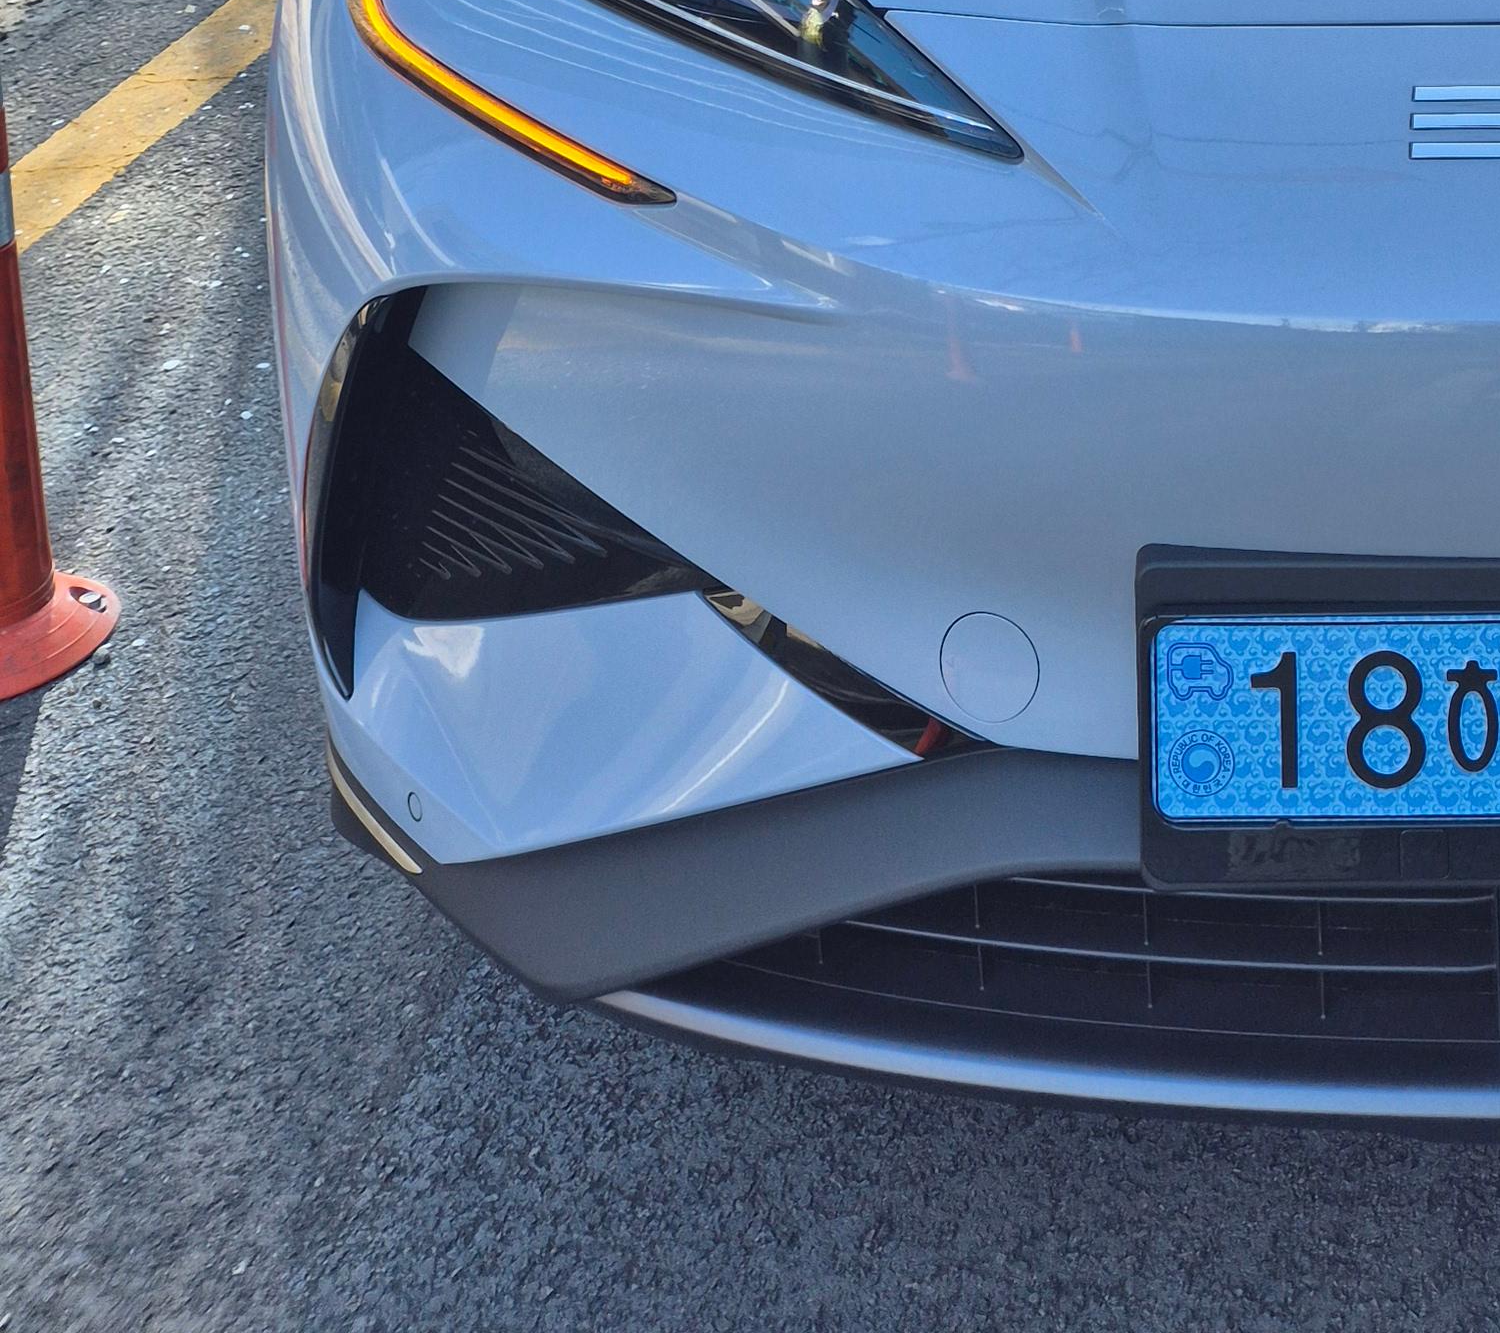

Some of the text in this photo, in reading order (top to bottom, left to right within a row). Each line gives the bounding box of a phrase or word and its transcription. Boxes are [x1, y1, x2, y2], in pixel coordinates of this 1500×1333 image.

[1172, 734, 1232, 774] REPUBLIC OF KOREA
